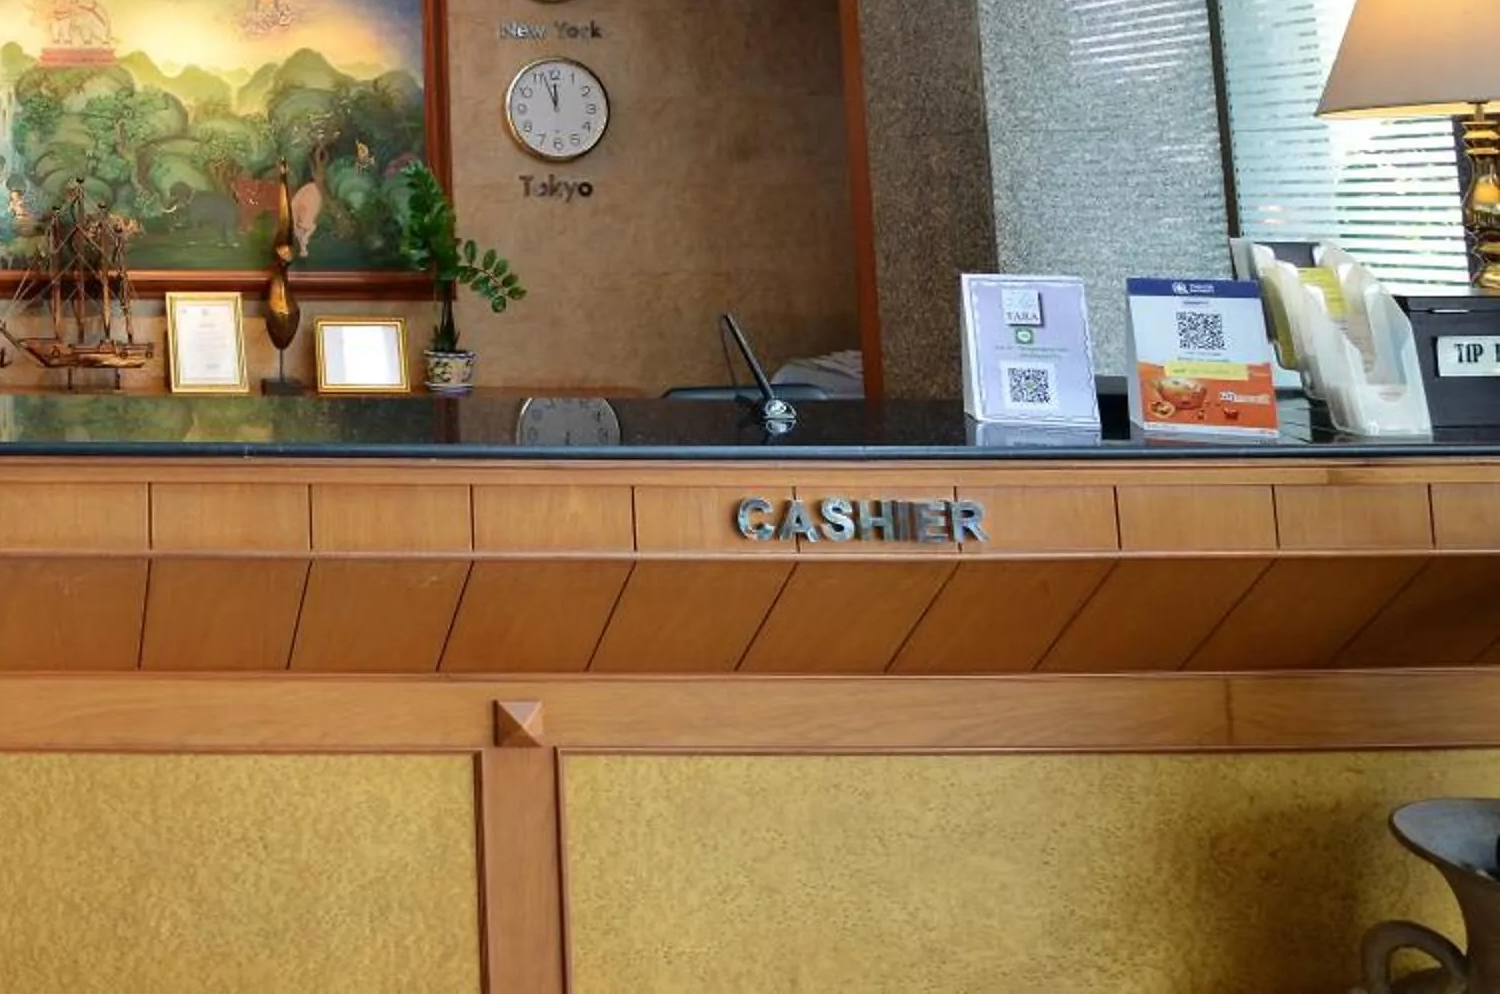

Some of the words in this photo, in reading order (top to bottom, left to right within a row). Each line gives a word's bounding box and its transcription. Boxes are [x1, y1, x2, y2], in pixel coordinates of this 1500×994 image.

[500, 20, 547, 39] New
[554, 18, 603, 39] York
[519, 174, 594, 203] Tokyo
[1453, 343, 1484, 363] TIP
[734, 496, 991, 543] CASHIER
